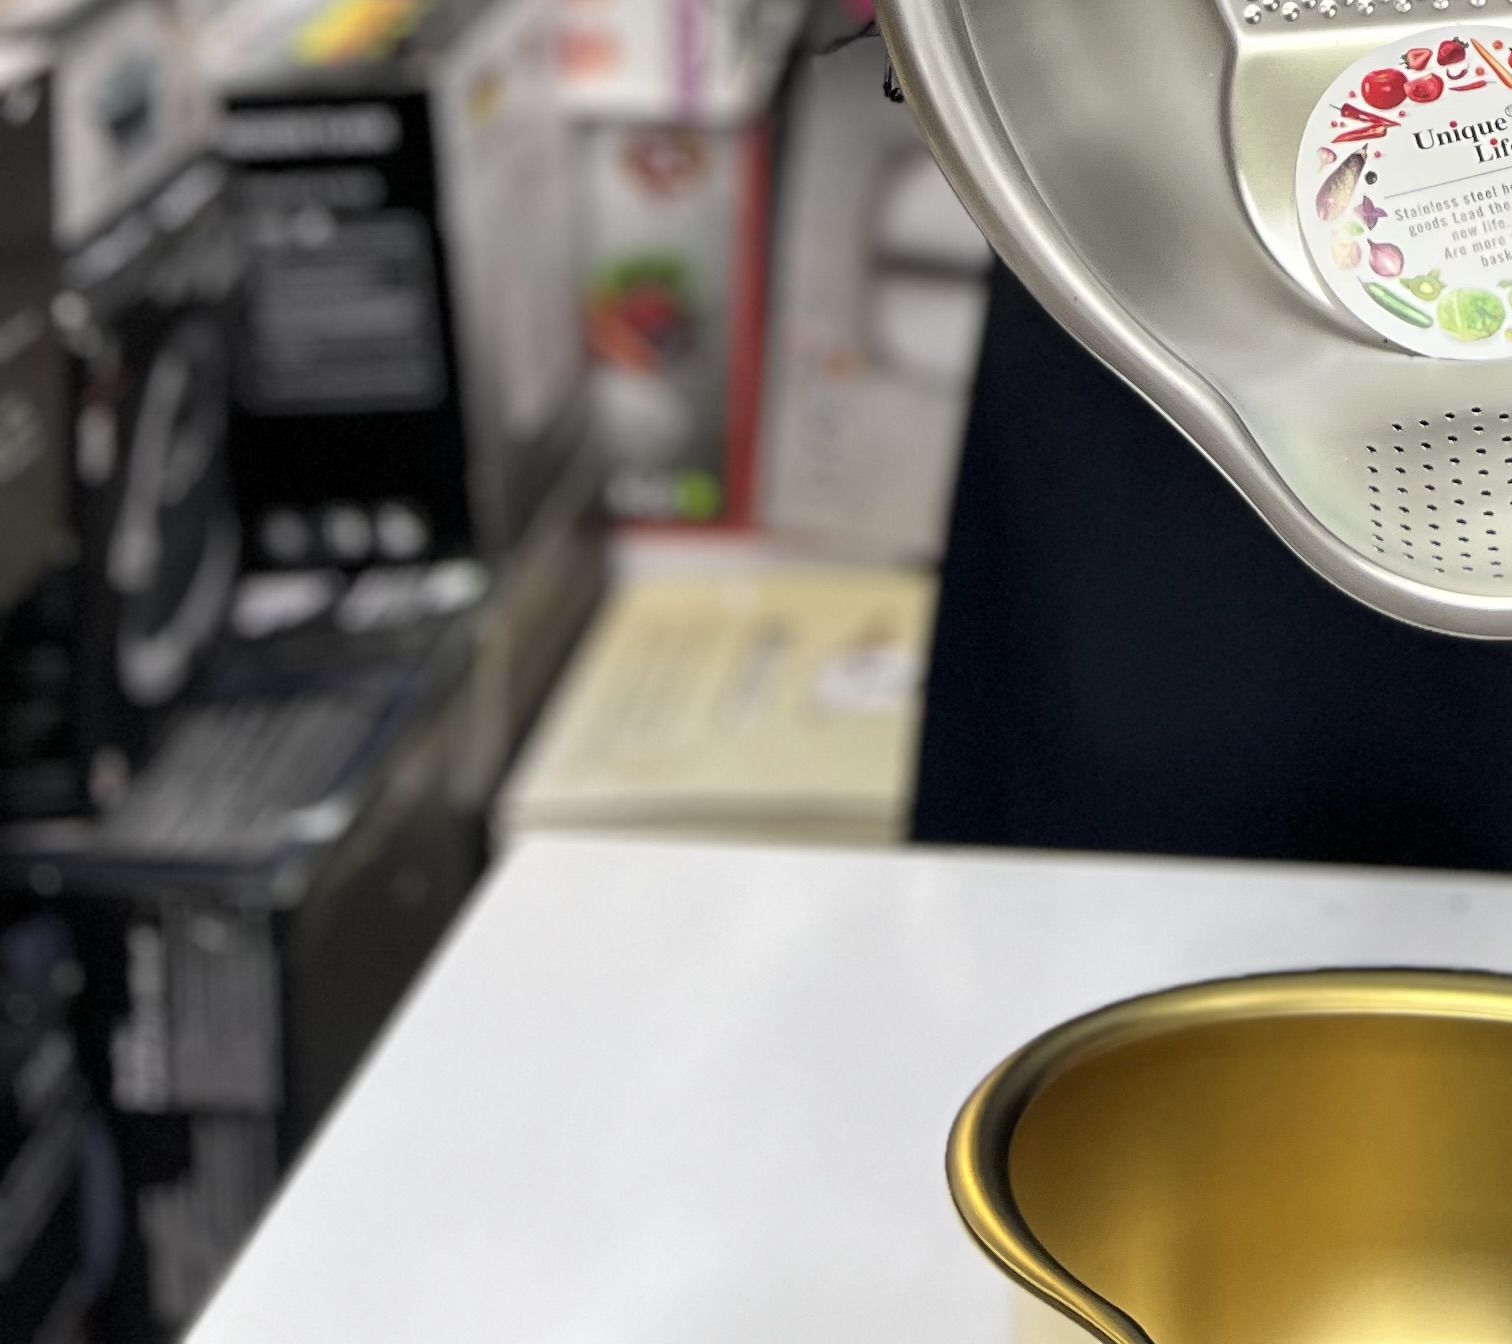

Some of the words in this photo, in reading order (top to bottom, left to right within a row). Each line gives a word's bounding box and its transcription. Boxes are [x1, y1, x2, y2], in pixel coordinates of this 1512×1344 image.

[1394, 197, 1459, 221] Stainless
[1463, 185, 1498, 205] steel
[1408, 216, 1449, 238] goods
[1488, 201, 1511, 215] the
[1451, 225, 1477, 242] new
[1444, 246, 1467, 261] Are
[1472, 235, 1506, 253] more
